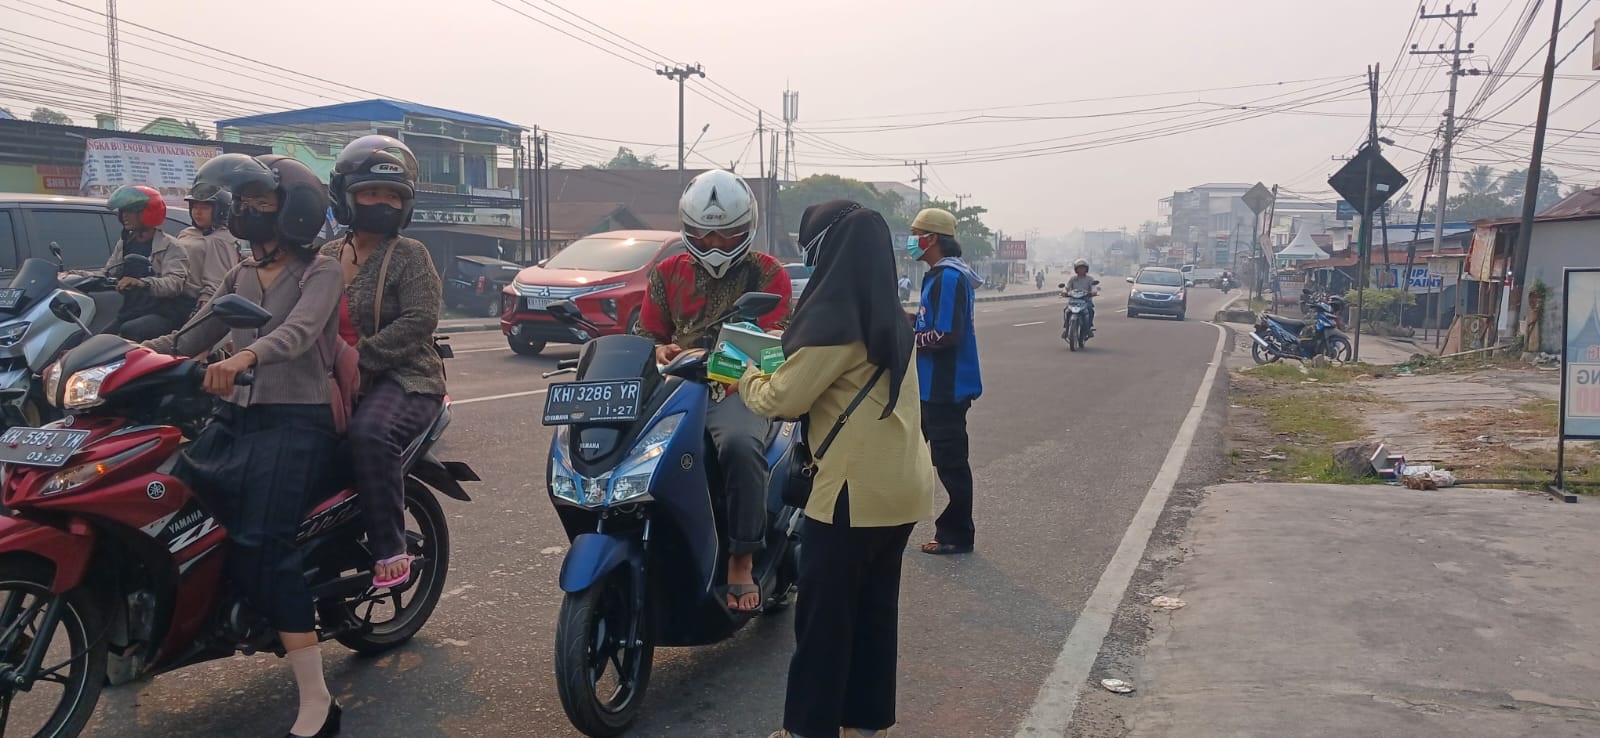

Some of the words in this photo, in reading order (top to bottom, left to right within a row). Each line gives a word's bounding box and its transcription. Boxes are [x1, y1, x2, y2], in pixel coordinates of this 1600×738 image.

[577, 386, 612, 401] 3286
[620, 384, 637, 399] YR
[22, 431, 59, 446] 5951
[168, 509, 204, 534] YAMAHA
